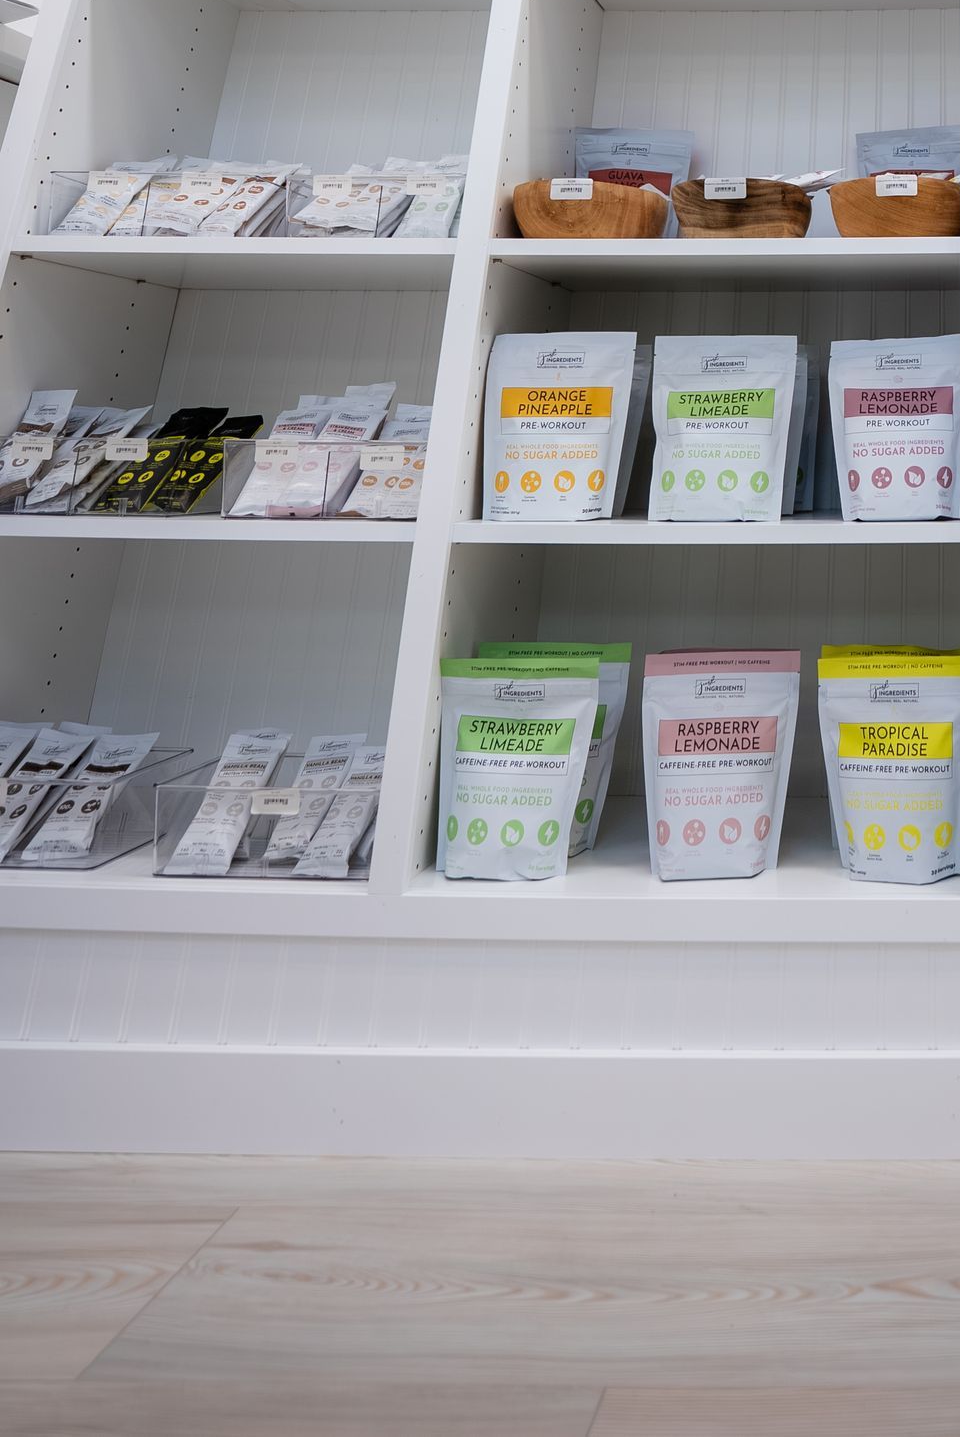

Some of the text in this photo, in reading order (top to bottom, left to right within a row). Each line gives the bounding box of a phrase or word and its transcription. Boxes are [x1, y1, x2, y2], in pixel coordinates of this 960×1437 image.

[608, 171, 644, 181] GUAVA
[527, 390, 586, 401] ORANGE
[679, 392, 764, 404] STRAWBERRY
[861, 390, 936, 402] RASPBERRY
[518, 404, 593, 415] PINEAPPLE
[690, 405, 749, 416] LIMEADE
[859, 403, 938, 414] LEMONADE
[520, 422, 586, 430] PRE-WORKOUT
[866, 419, 930, 427] PRE-WORKOUT
[524, 451, 557, 459] SUGAR
[562, 451, 598, 459] ADDED
[672, 450, 760, 459] NO SUGAR ADDED
[853, 446, 944, 458] NO SUGAR ADDED
[470, 720, 563, 735] STRAWBERRY
[678, 720, 760, 736] RASPBERRY
[860, 726, 929, 740] TROPICAL
[480, 738, 544, 752] LIMEADE
[674, 737, 760, 752] LEMONADE
[862, 743, 927, 756] PARADISE
[456, 793, 552, 806] NO SUGAR ADDED
[664, 792, 763, 806] NO SUGAR ADDED
